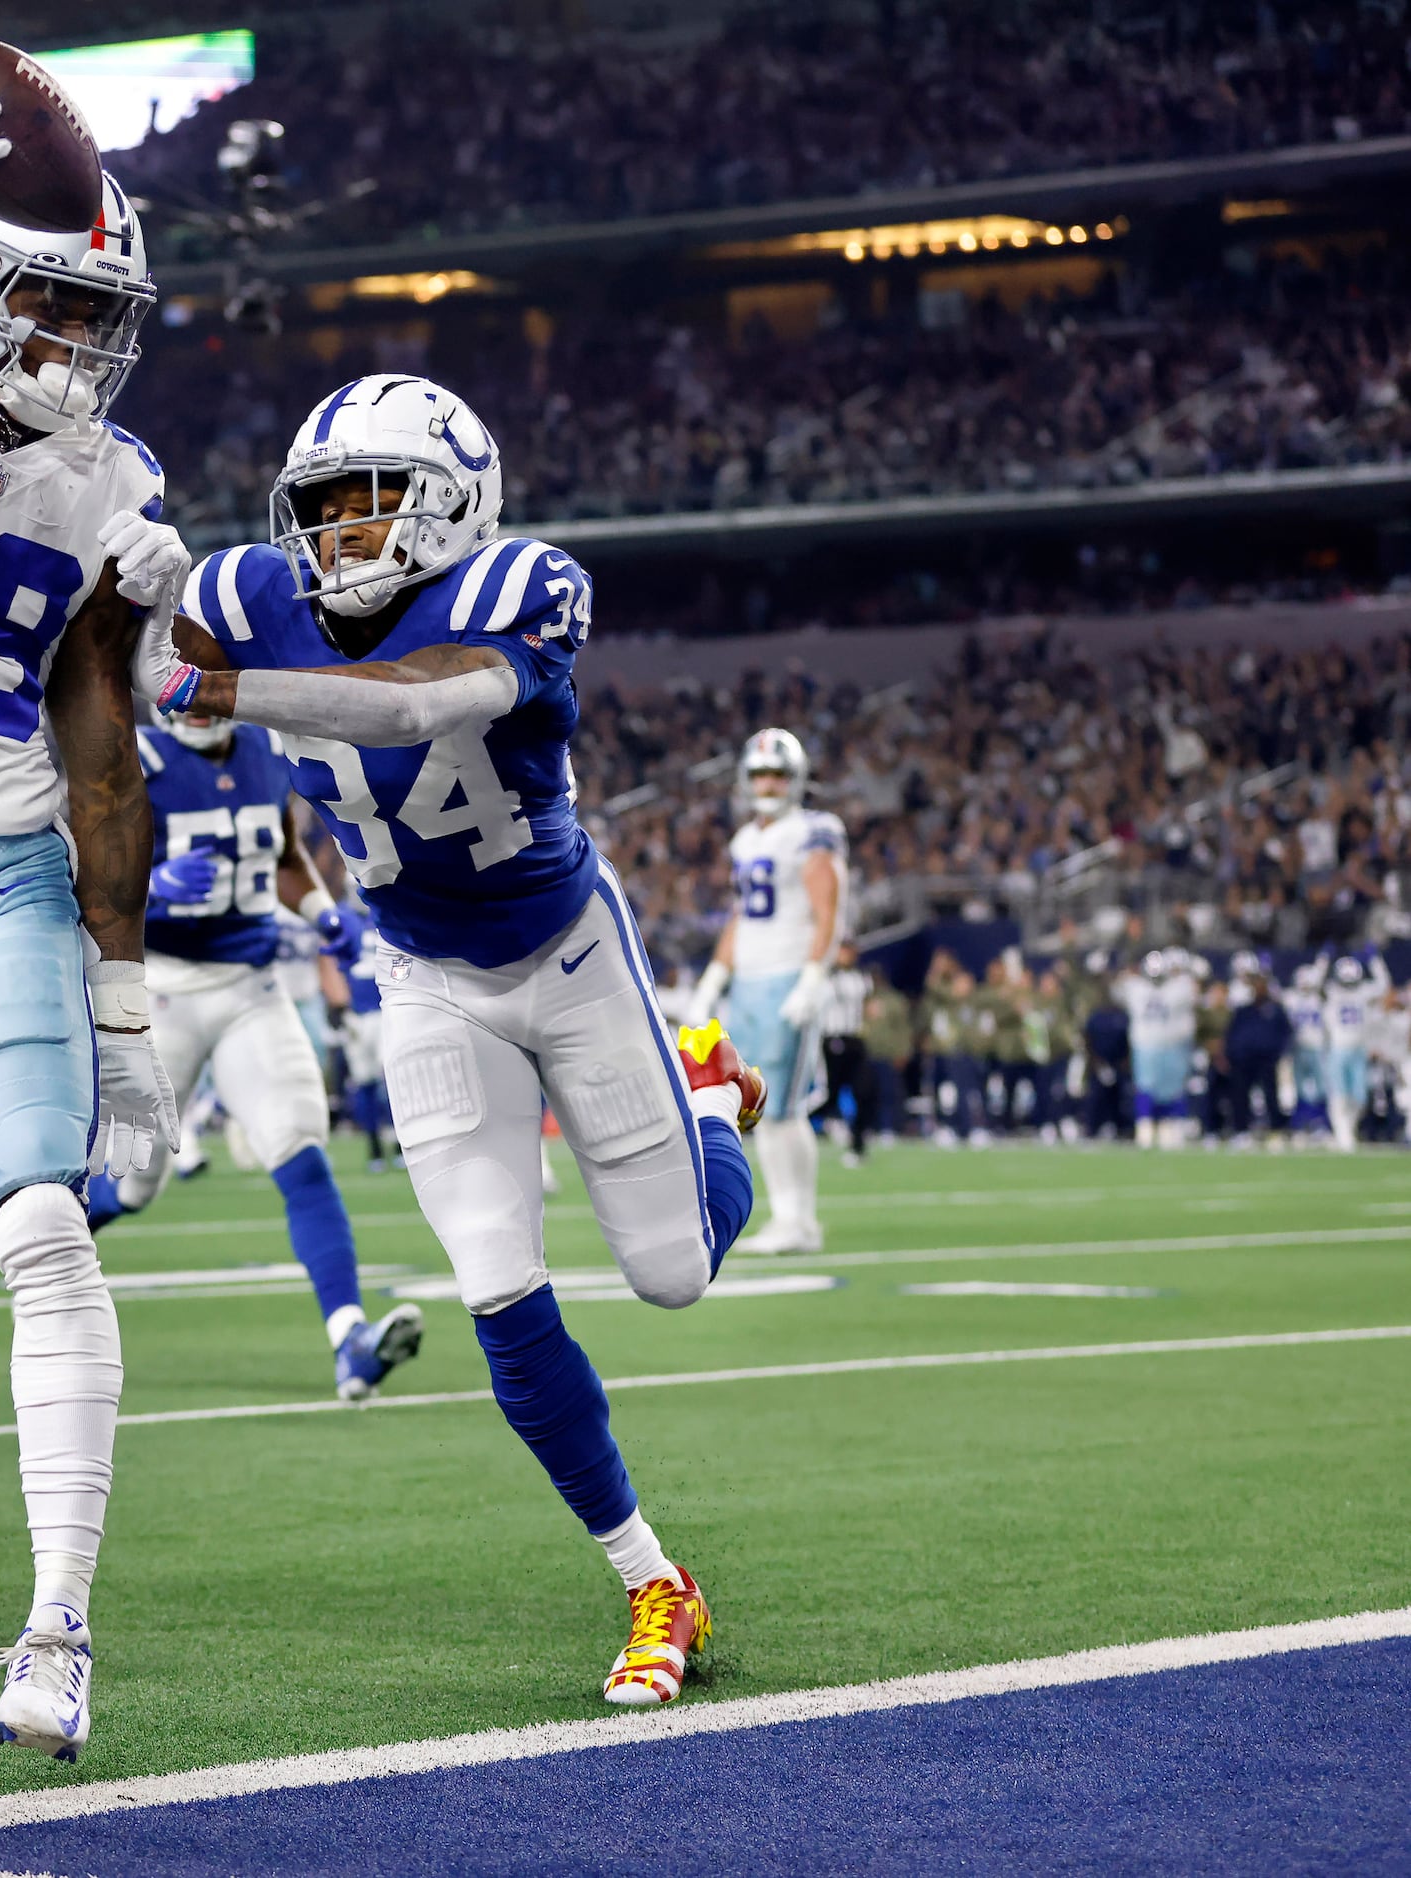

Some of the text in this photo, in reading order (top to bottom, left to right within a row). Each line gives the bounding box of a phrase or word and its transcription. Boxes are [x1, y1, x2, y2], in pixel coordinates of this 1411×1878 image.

[305, 447, 329, 460] COLTS
[540, 577, 591, 640] 34
[282, 716, 534, 889] 34
[166, 803, 285, 918] 58
